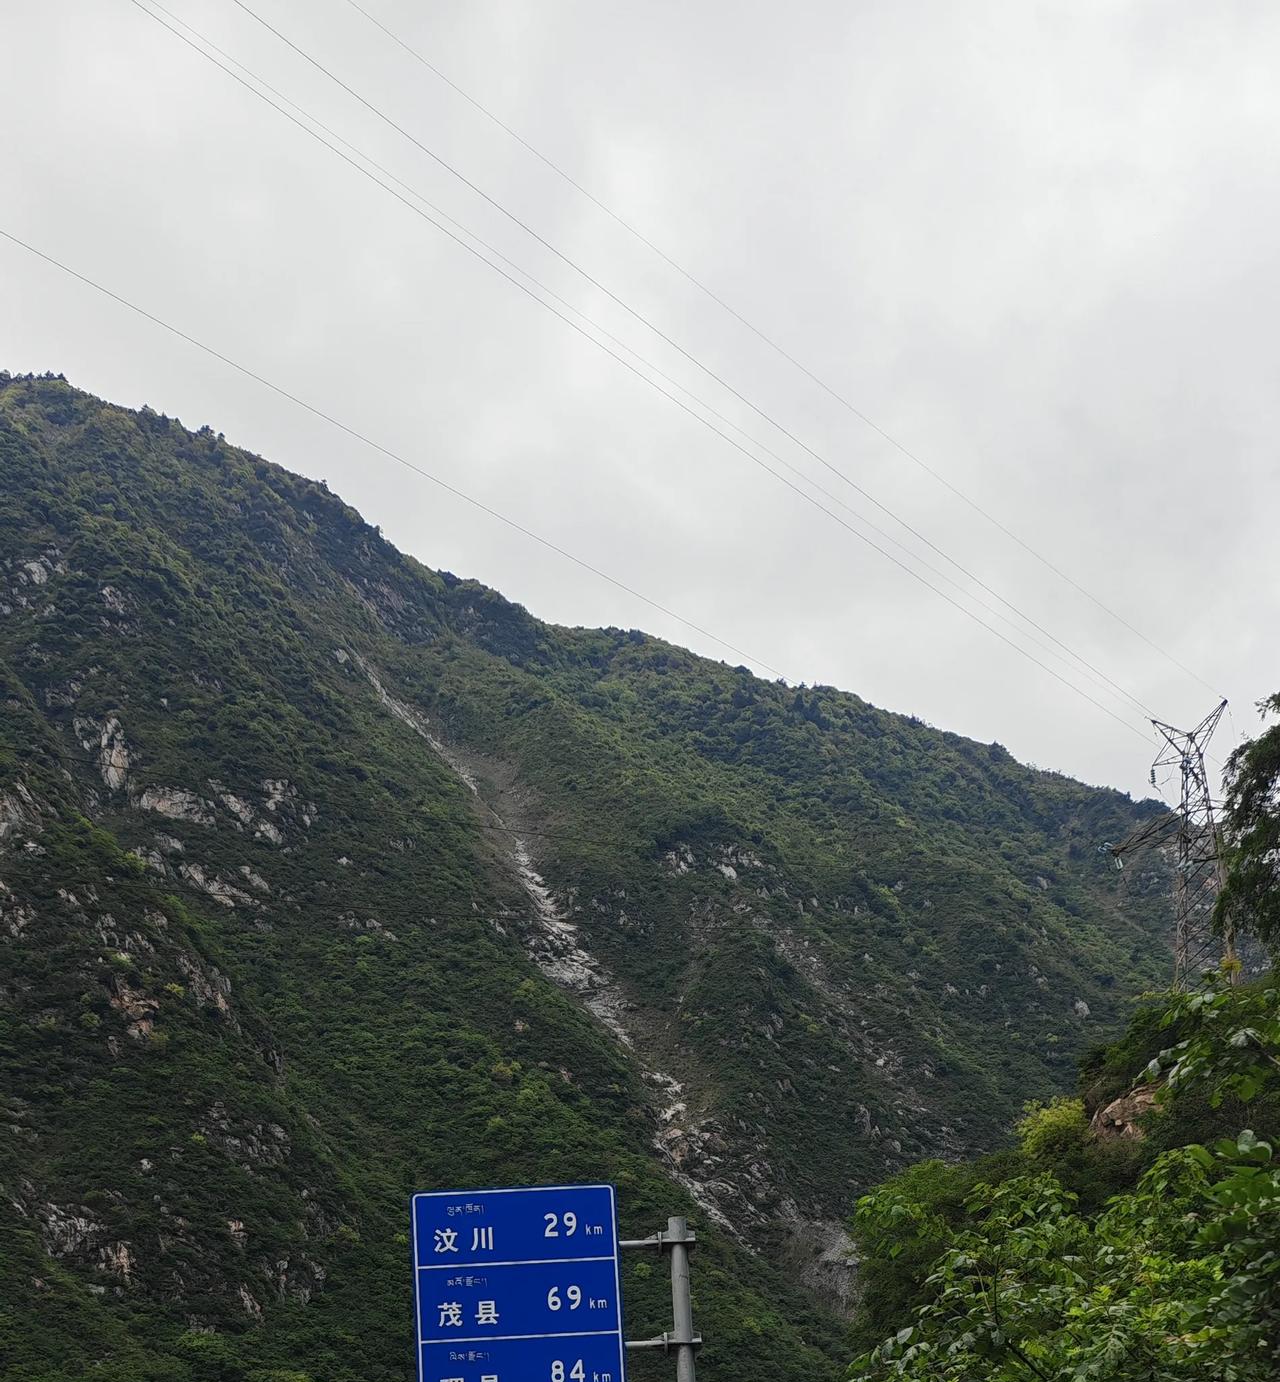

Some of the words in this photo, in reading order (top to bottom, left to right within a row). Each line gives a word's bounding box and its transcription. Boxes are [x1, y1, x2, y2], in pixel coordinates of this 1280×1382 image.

[433, 1226, 494, 1253] 汶川
[543, 1211, 577, 1238] 29
[585, 1223, 603, 1236] km
[437, 1300, 500, 1327] 茂县
[547, 1285, 582, 1311] 69
[589, 1297, 608, 1309] km
[593, 1371, 611, 1382] km
